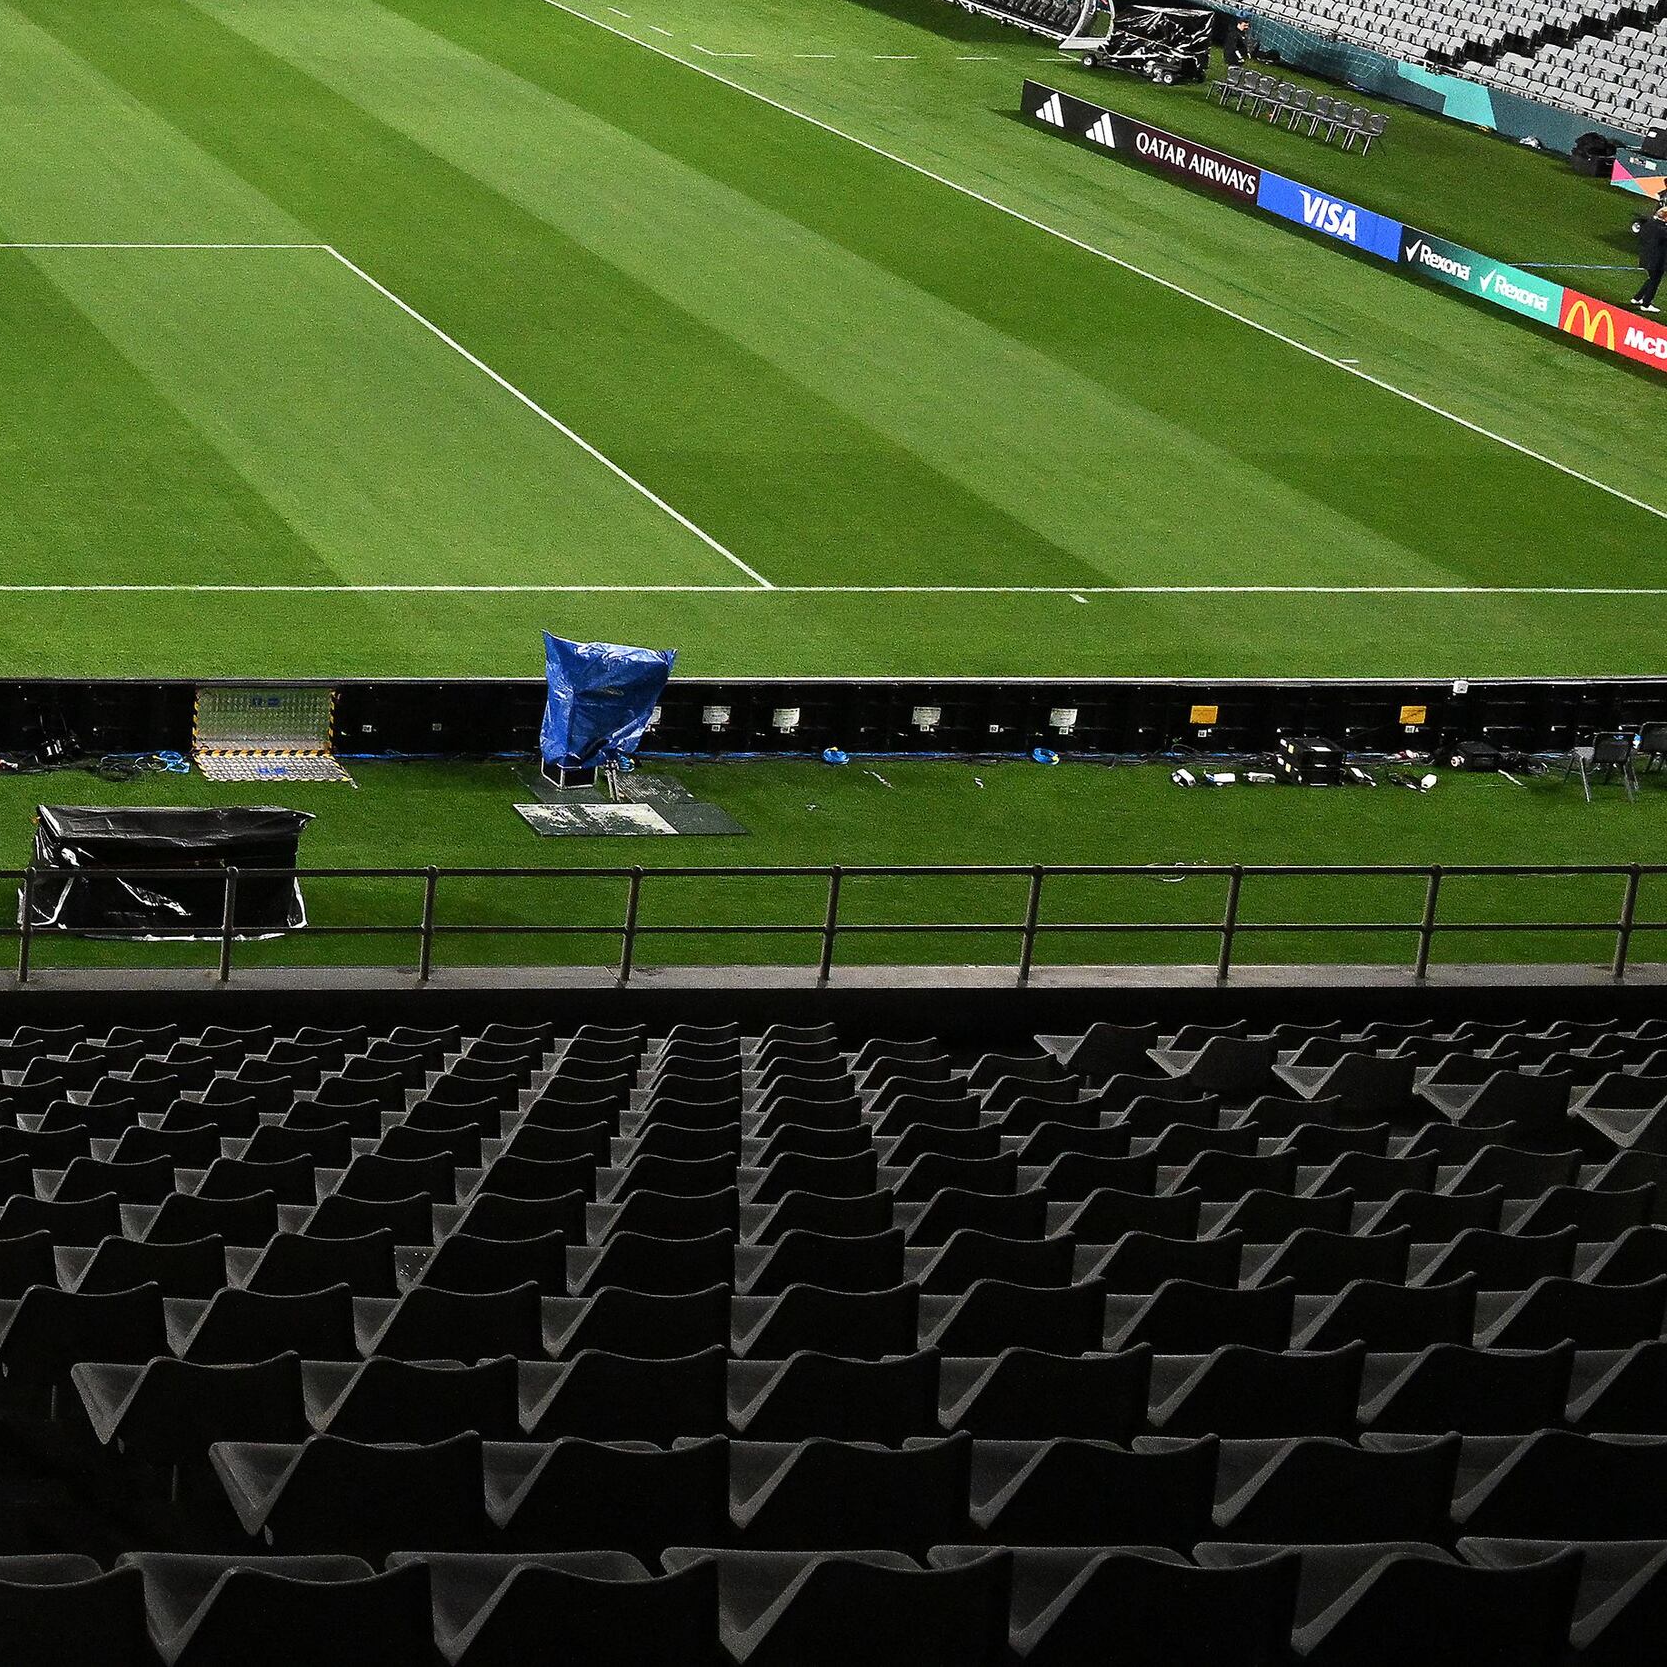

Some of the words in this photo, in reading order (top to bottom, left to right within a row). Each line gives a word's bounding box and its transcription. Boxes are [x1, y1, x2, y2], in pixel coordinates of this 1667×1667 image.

[1136, 133, 1186, 169] QATAR
[1189, 153, 1257, 196] AIRWAYS
[1299, 190, 1356, 241] VISA
[1419, 245, 1471, 281] Rexona
[1494, 275, 1549, 313] Rexona
